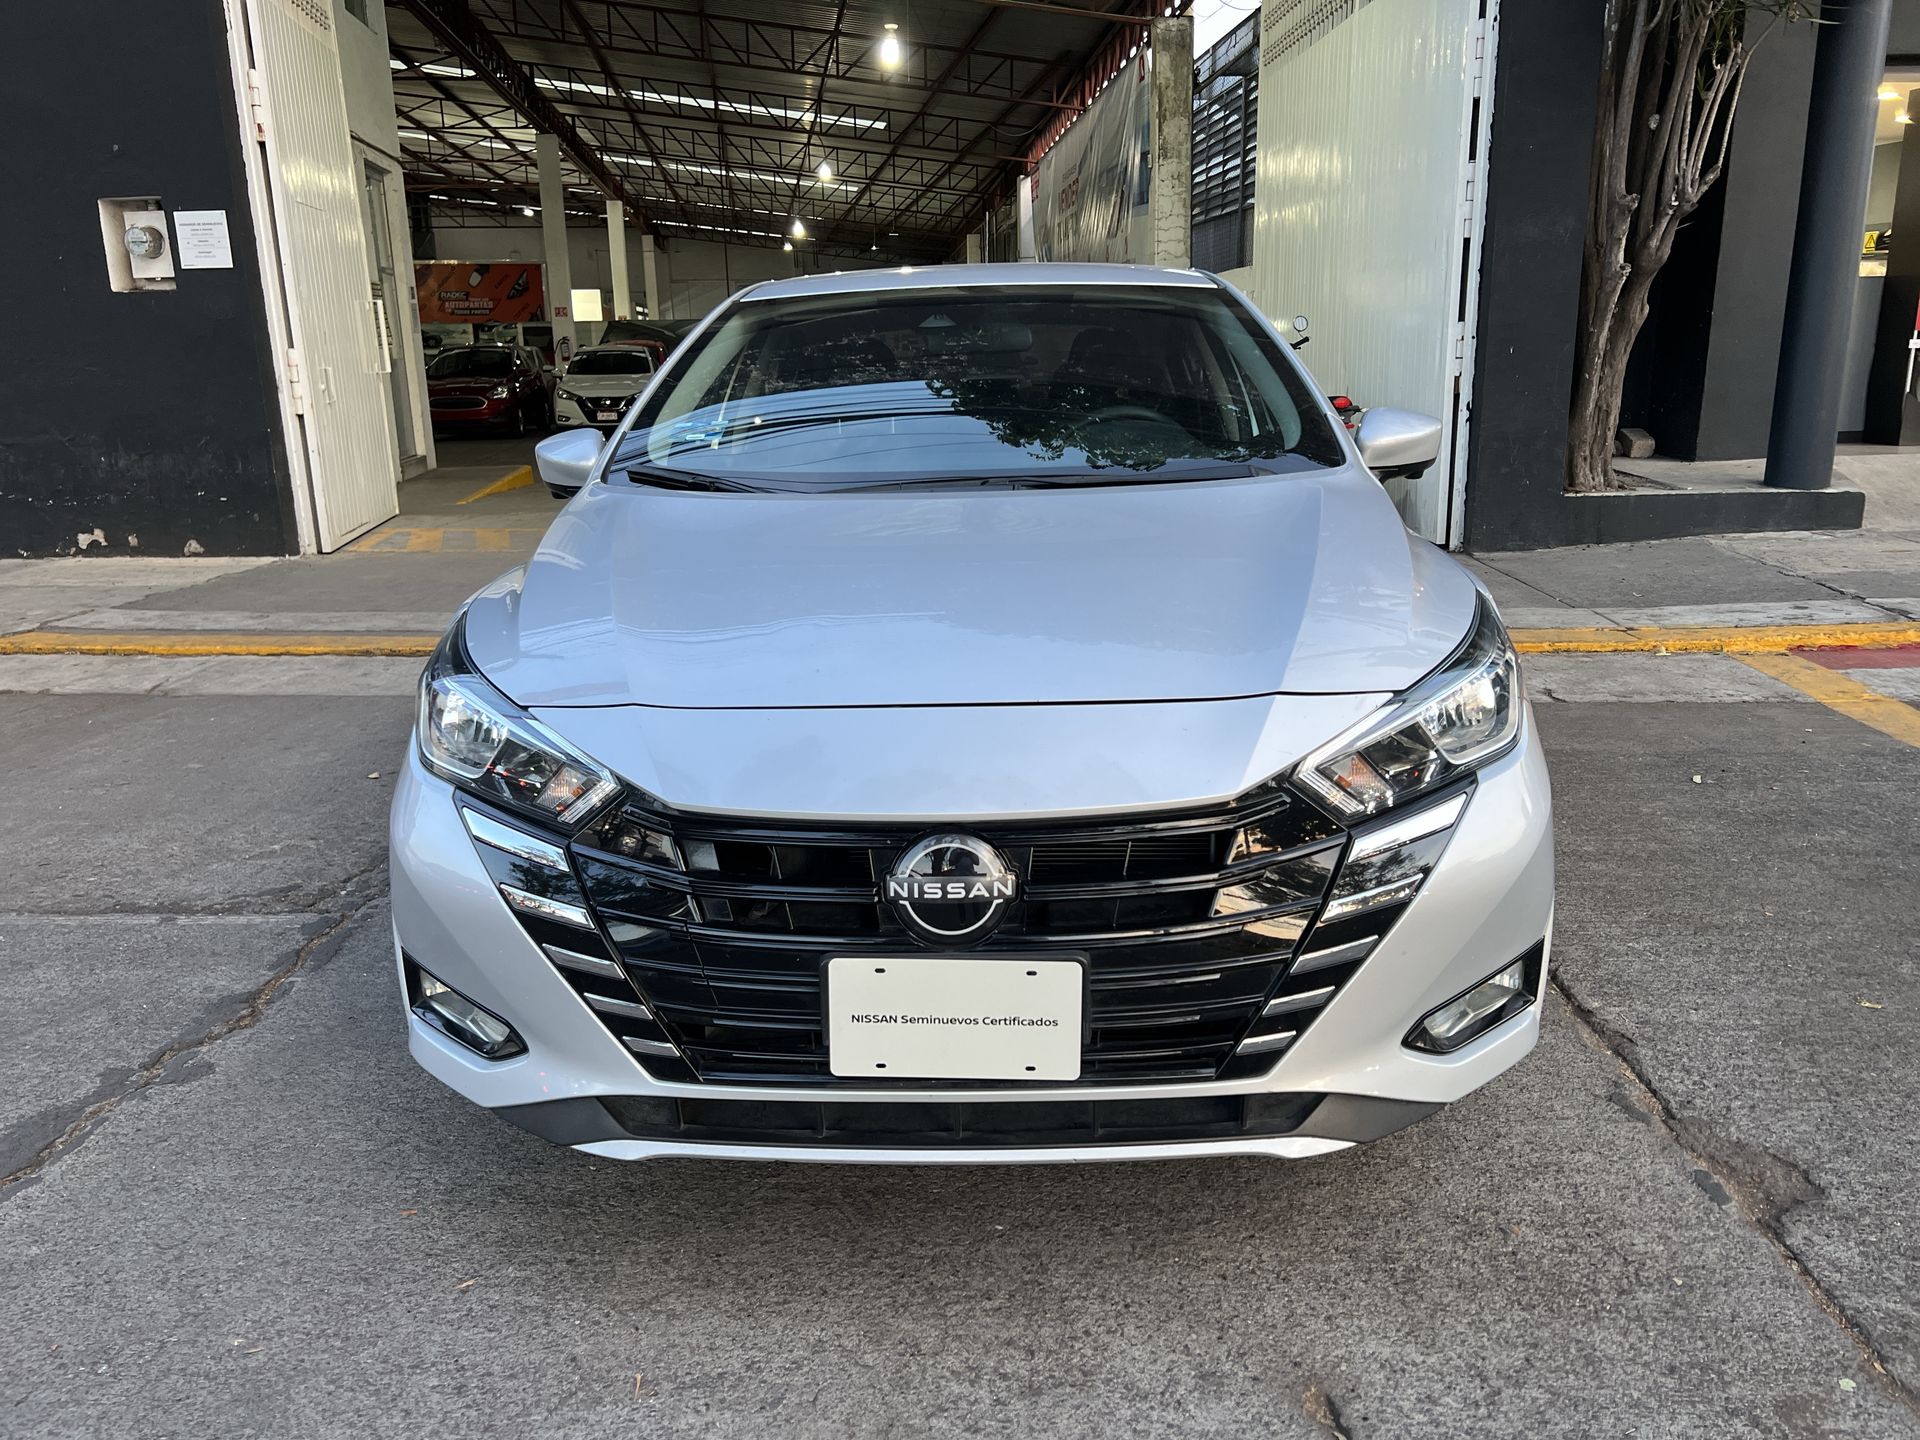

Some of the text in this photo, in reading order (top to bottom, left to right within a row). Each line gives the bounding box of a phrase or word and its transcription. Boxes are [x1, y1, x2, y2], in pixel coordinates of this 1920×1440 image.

[440, 291, 466, 299] RADEC
[444, 301, 494, 309] AUTOPARTES
[889, 881, 1013, 899] NISSAN
[851, 1014, 1059, 1027] NISSAN Seminuevos Certificados
